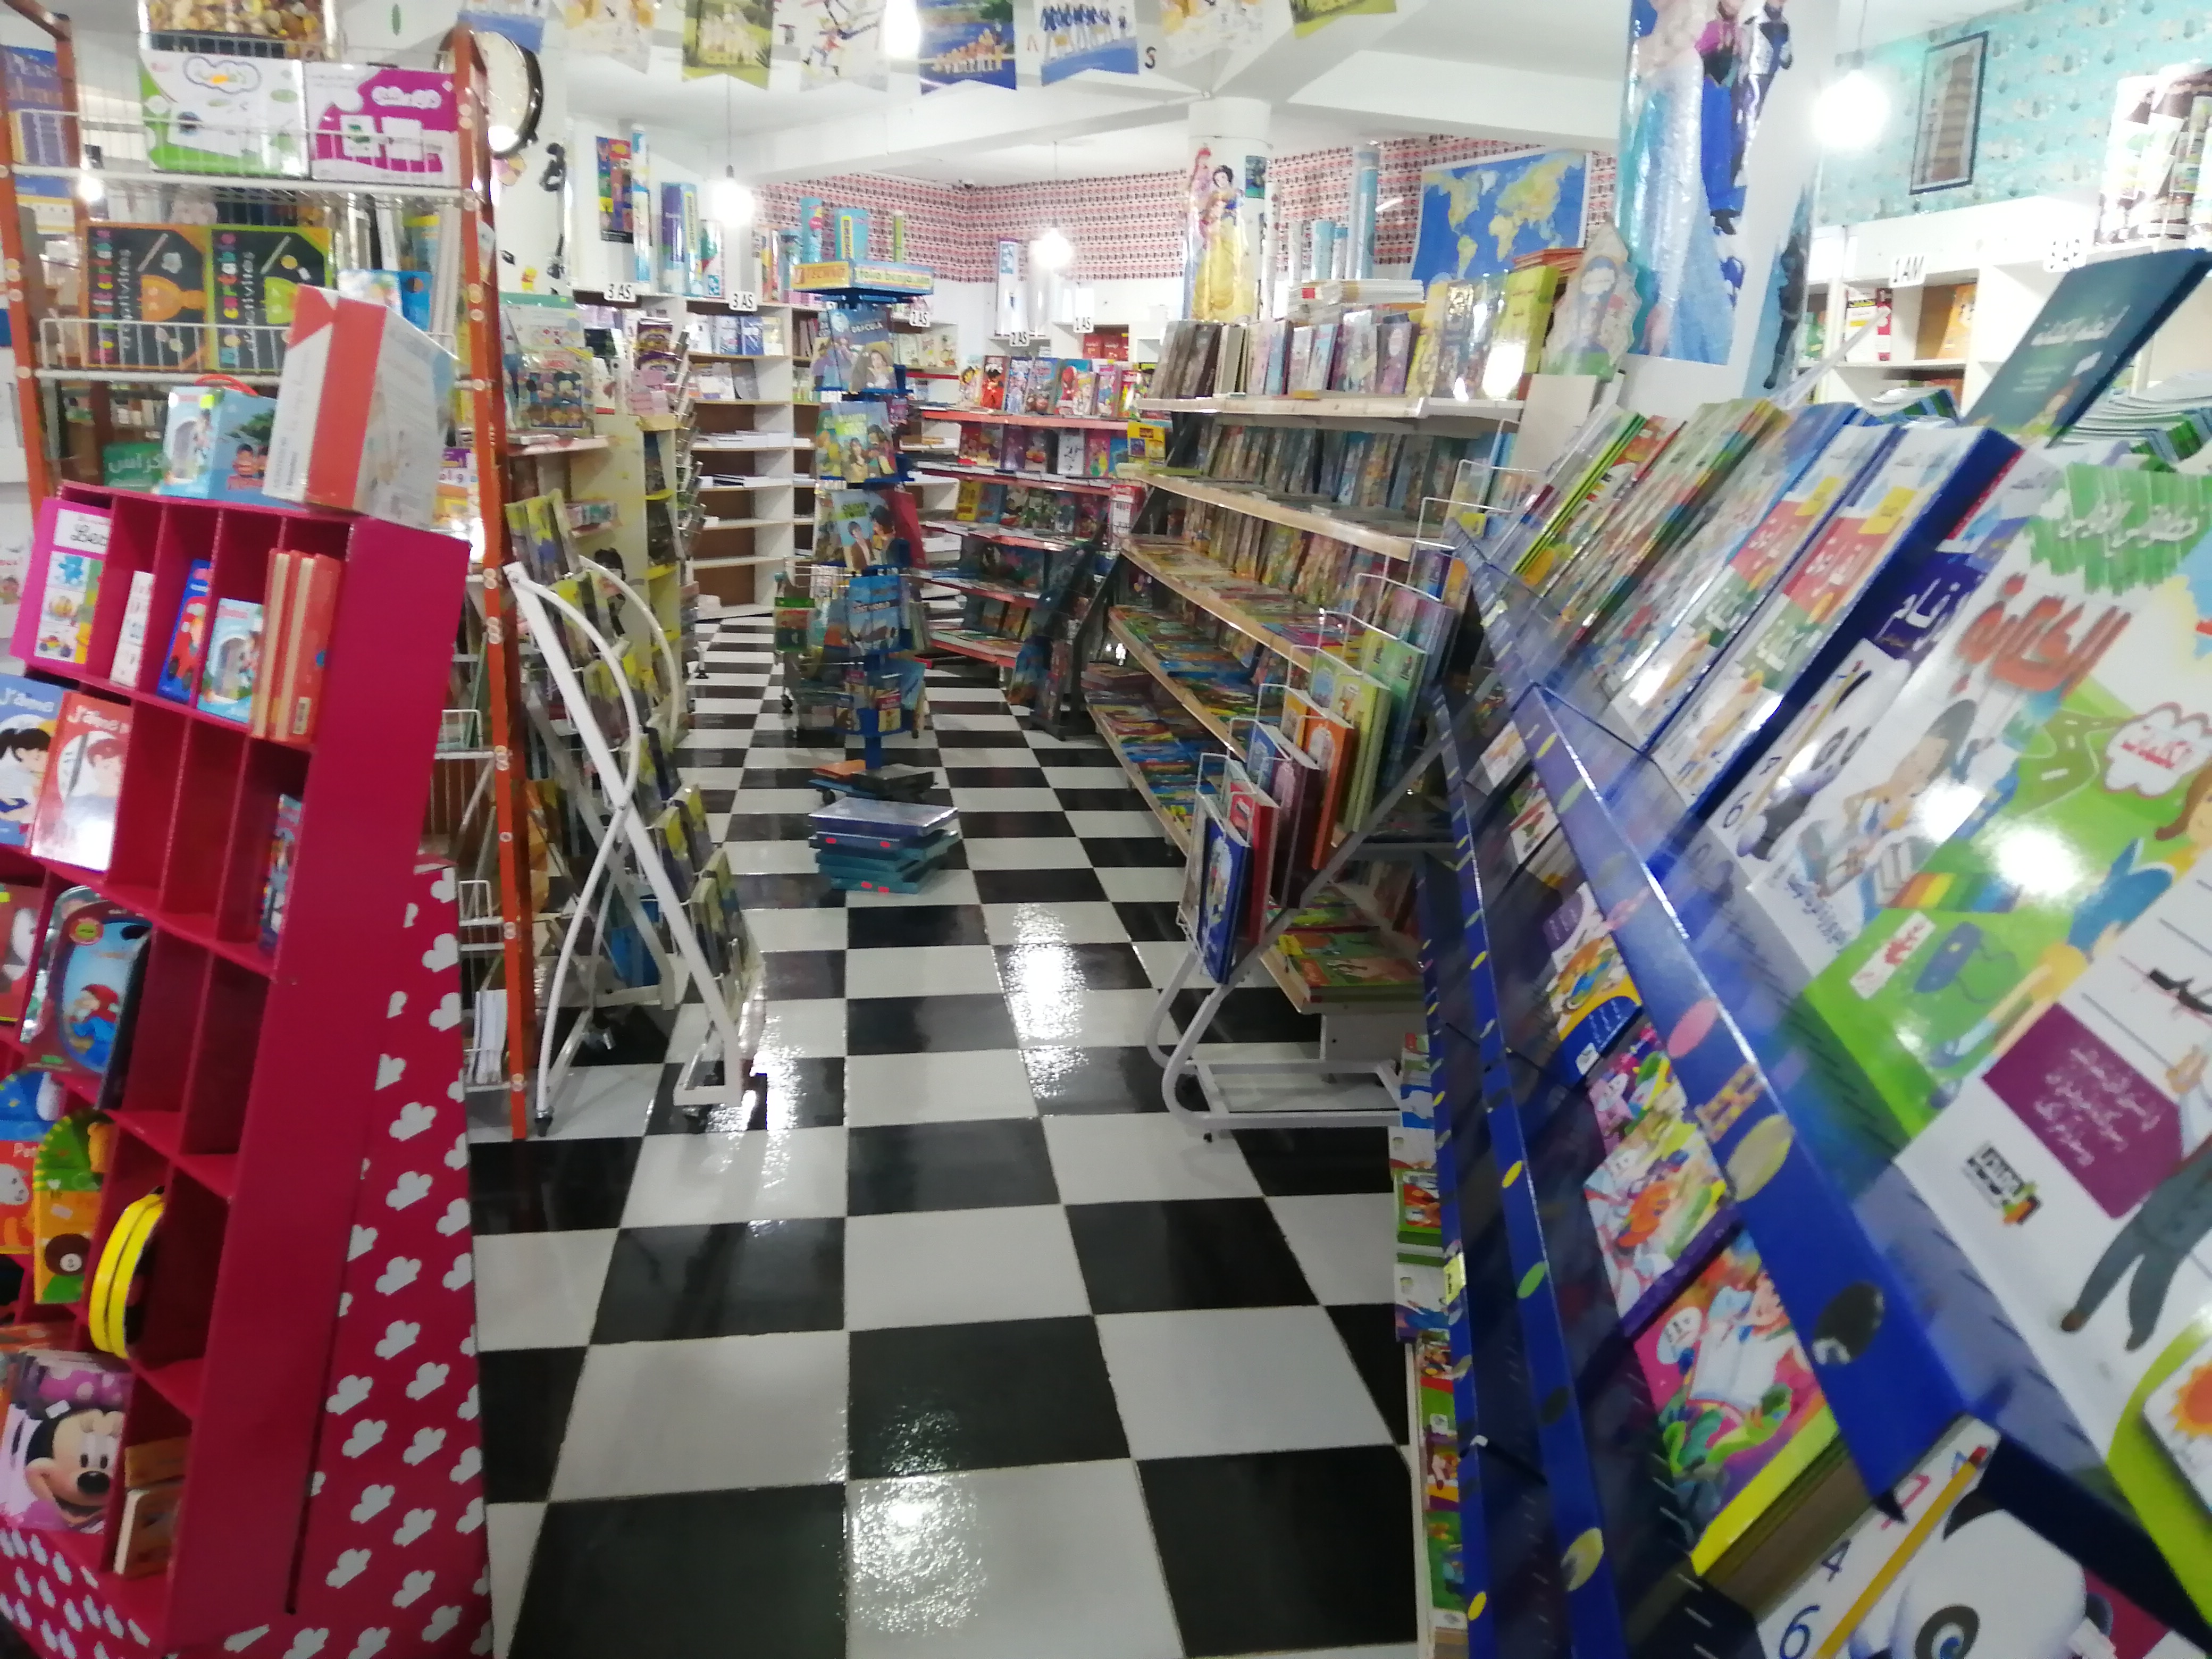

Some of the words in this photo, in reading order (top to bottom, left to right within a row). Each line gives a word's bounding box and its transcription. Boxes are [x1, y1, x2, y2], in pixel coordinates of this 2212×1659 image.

[608, 283, 615, 299] 3
[618, 283, 632, 300] AS
[733, 293, 739, 308] 3
[742, 294, 754, 308] AS
[918, 312, 928, 325] AS
[1082, 317, 1091, 330] AS
[1018, 331, 1027, 345] AS
[1821, 1538, 1852, 1582] 4
[1779, 1604, 1821, 1659] 6
